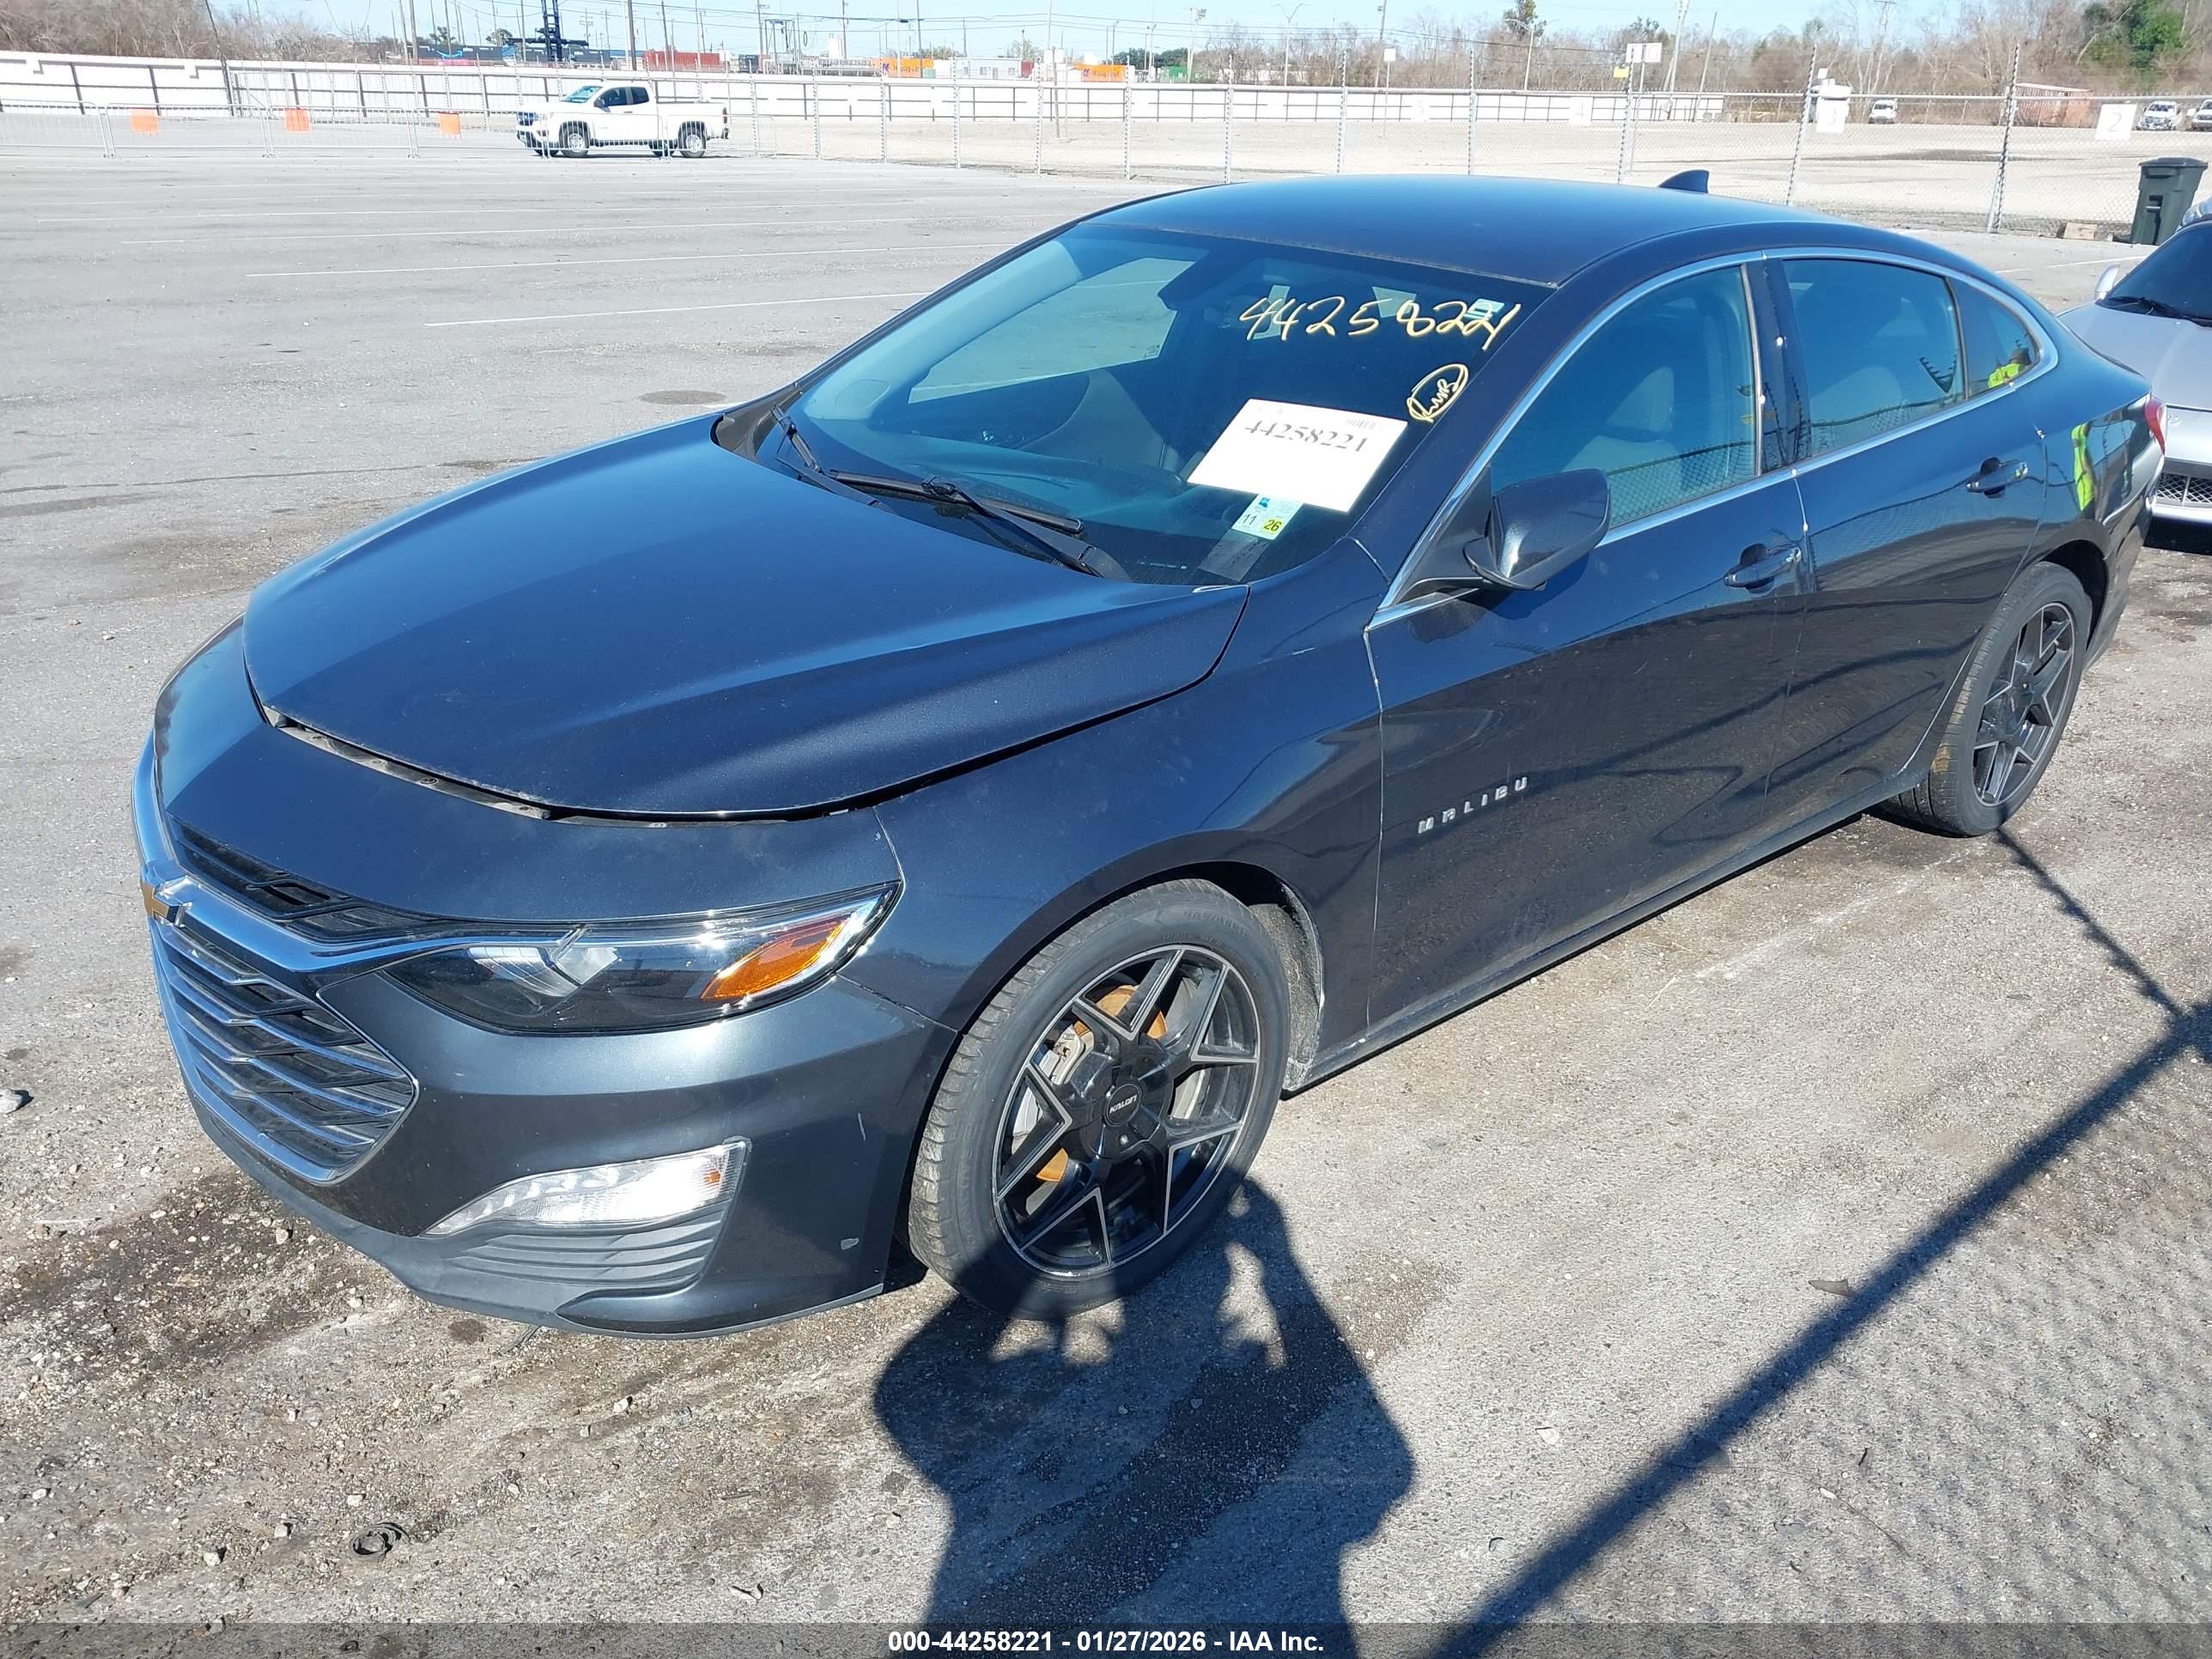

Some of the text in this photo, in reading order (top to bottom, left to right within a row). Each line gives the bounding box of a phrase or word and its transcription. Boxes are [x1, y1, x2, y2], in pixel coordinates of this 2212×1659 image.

[2108, 111, 2123, 132] 2
[1239, 295, 1522, 351] 44258221
[1245, 420, 1368, 452] 44258221
[1263, 519, 1282, 532] 26
[1418, 776, 1528, 835] MALIBU
